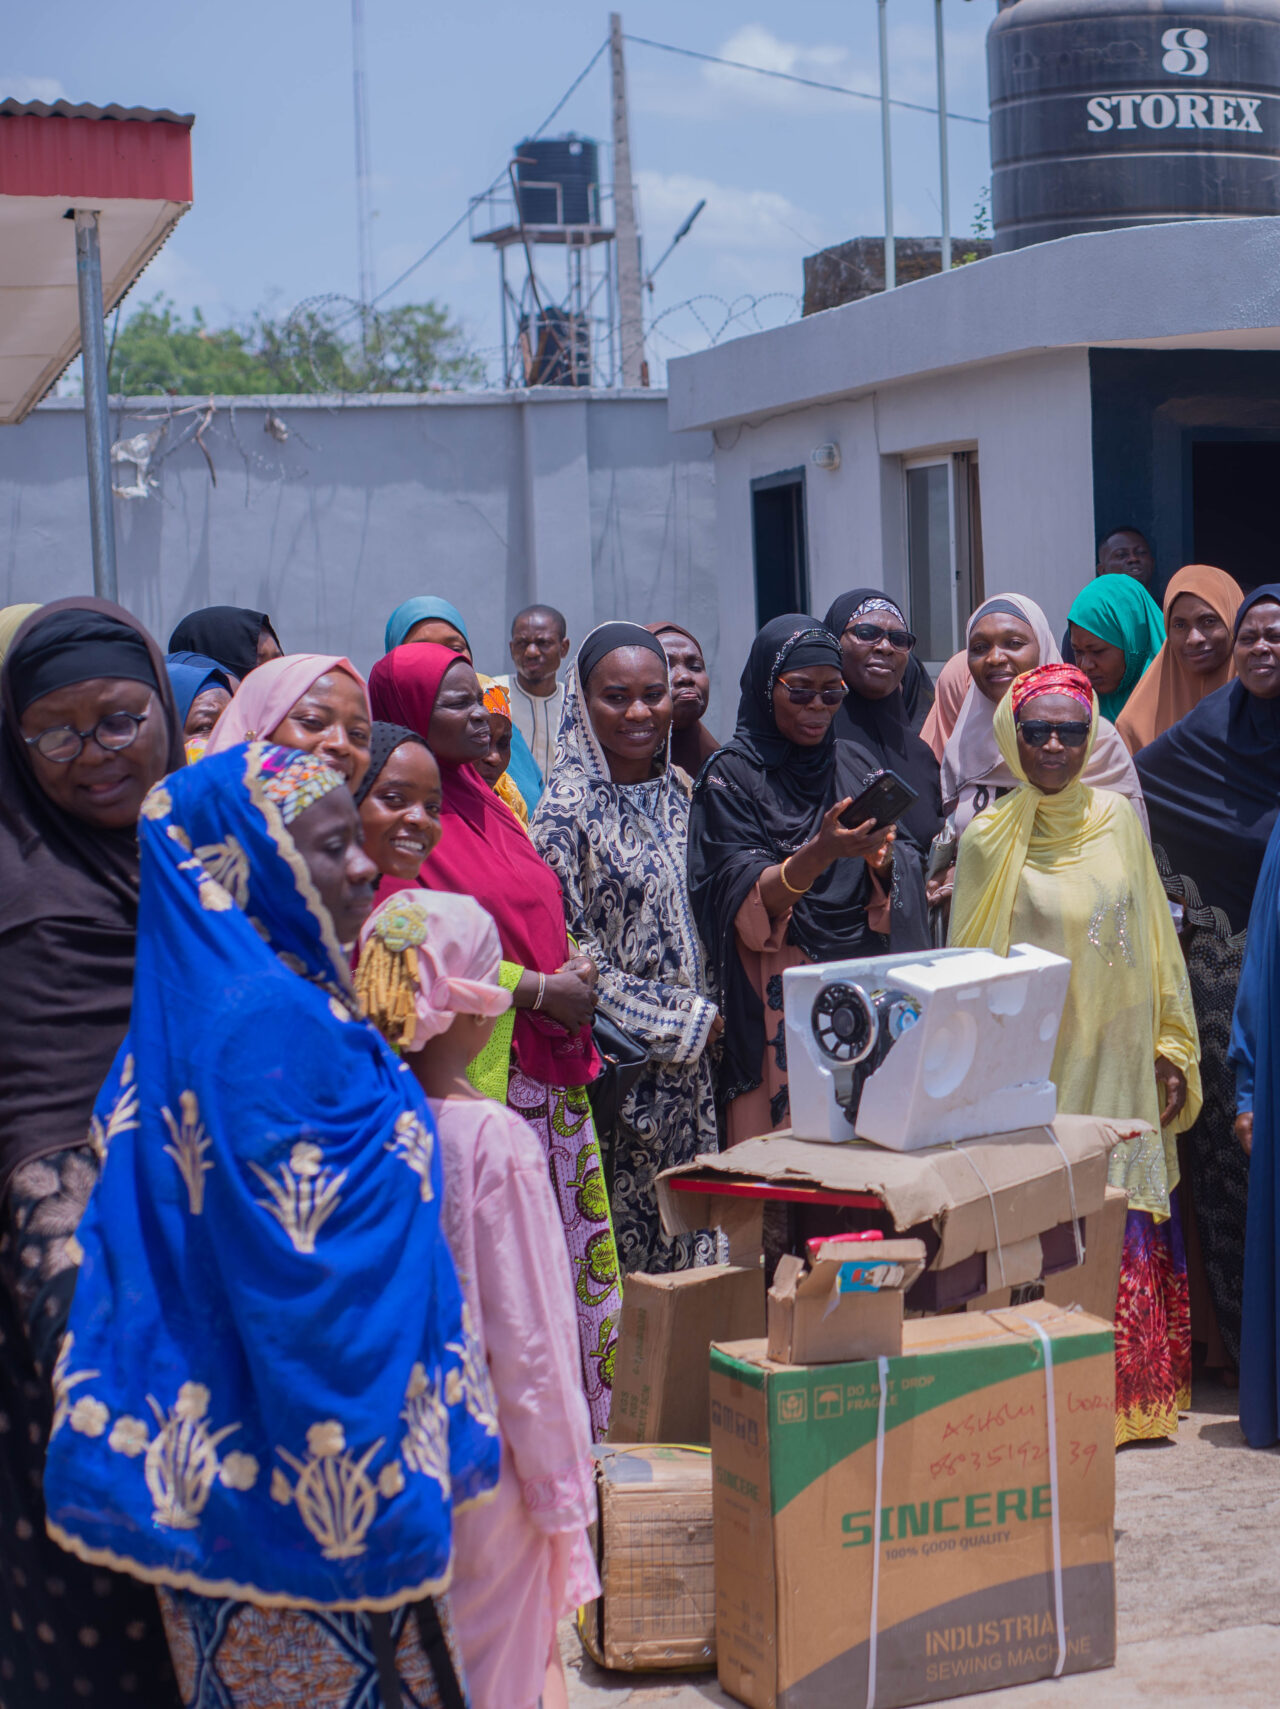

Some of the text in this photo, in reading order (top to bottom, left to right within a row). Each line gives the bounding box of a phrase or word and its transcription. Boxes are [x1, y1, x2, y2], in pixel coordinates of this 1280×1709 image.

[1086, 94, 1263, 133] STOREX
[847, 1375, 935, 1397] DO NT DROP
[847, 1394, 898, 1411] FRAGE
[842, 1484, 1054, 1548] SINCERE
[885, 1530, 1011, 1561] 100% GOOD QUALITY
[926, 1635, 1092, 1682] SEWING MACHNE
